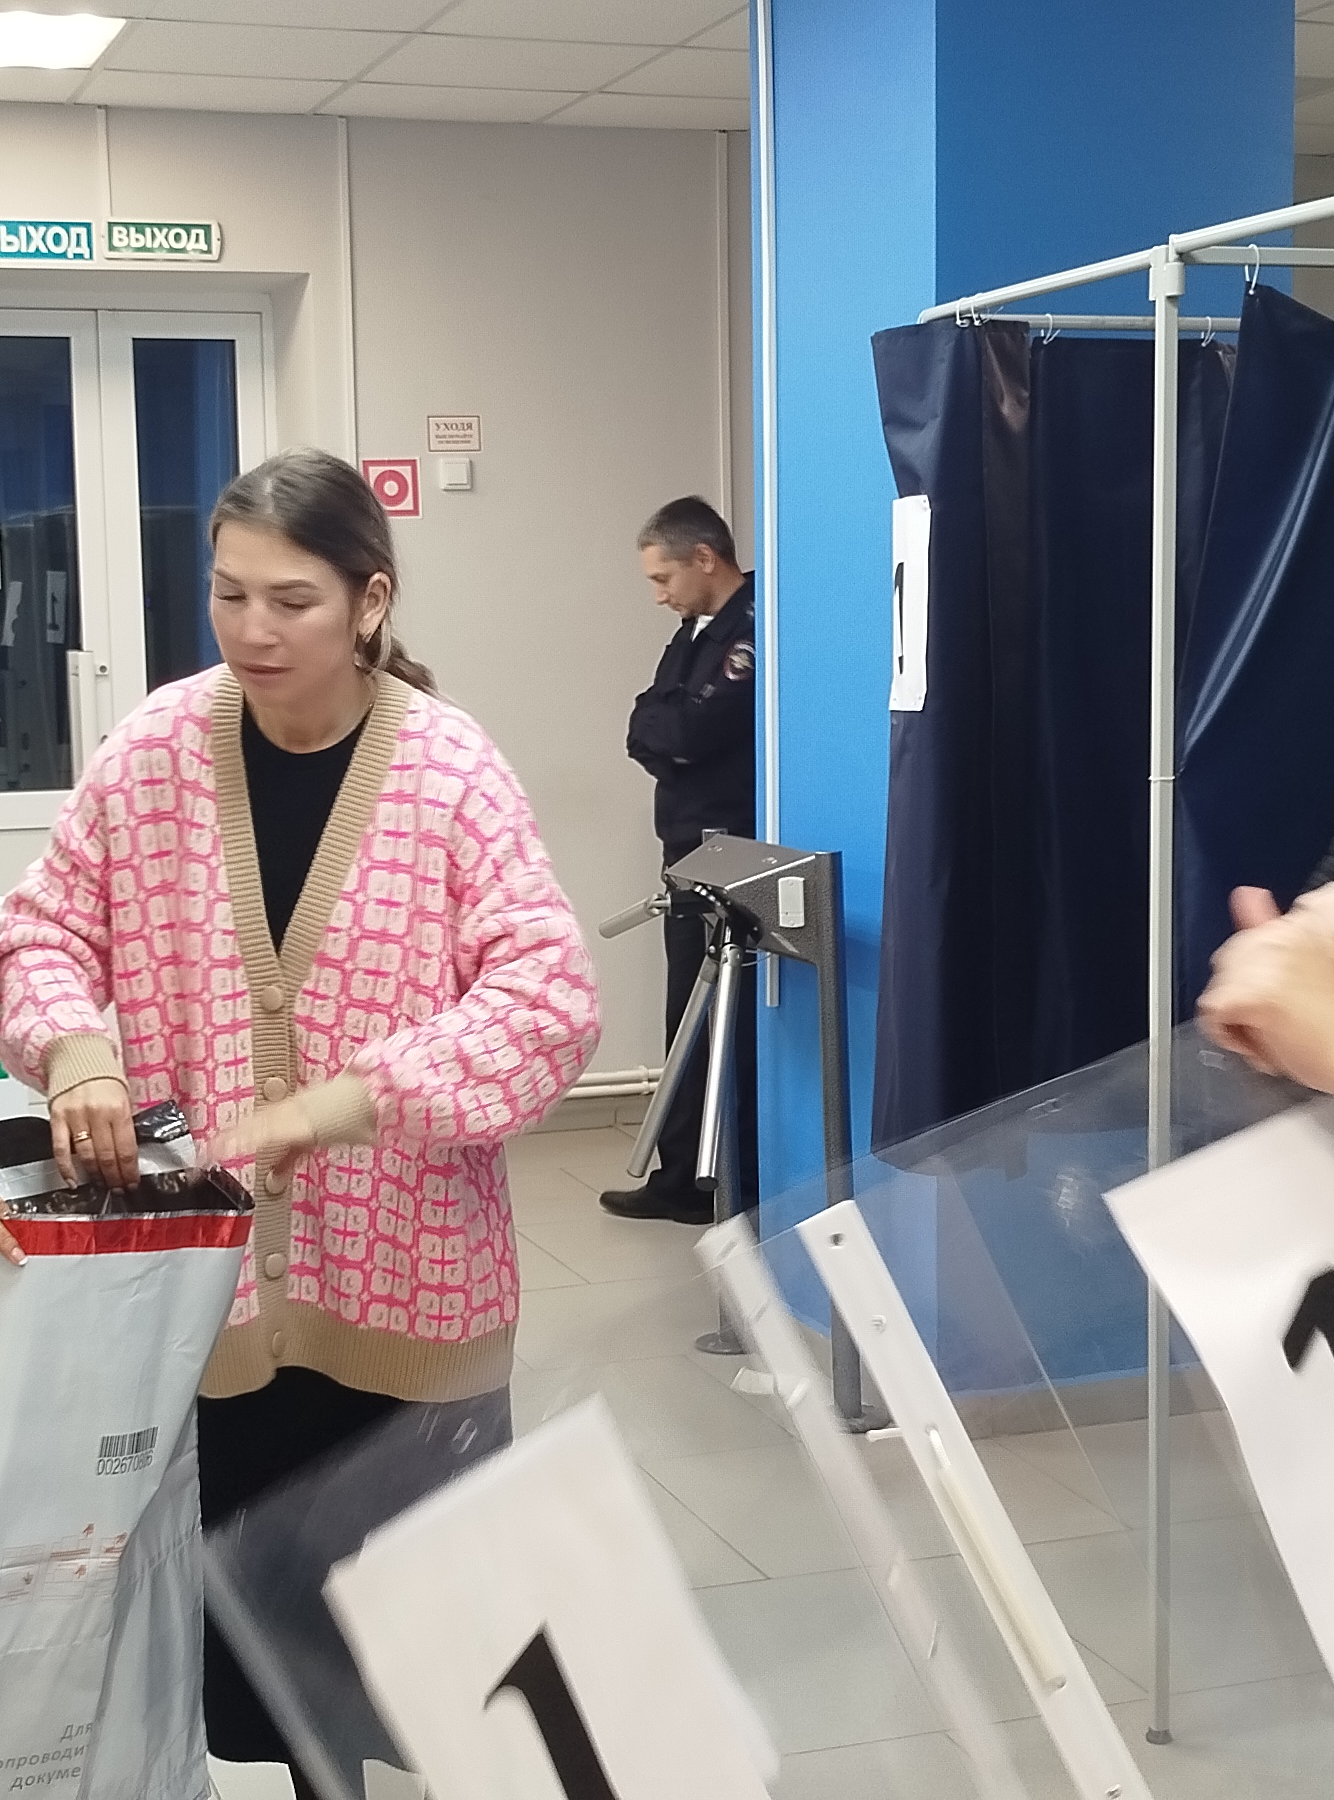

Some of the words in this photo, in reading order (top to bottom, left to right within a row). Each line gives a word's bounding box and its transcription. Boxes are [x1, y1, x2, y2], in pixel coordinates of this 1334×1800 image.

[112, 226, 208, 251] ВЫХОД
[435, 422, 473, 431] УХОДЯ
[482, 1622, 619, 1800] 1
[60, 1722, 93, 1742] Для
